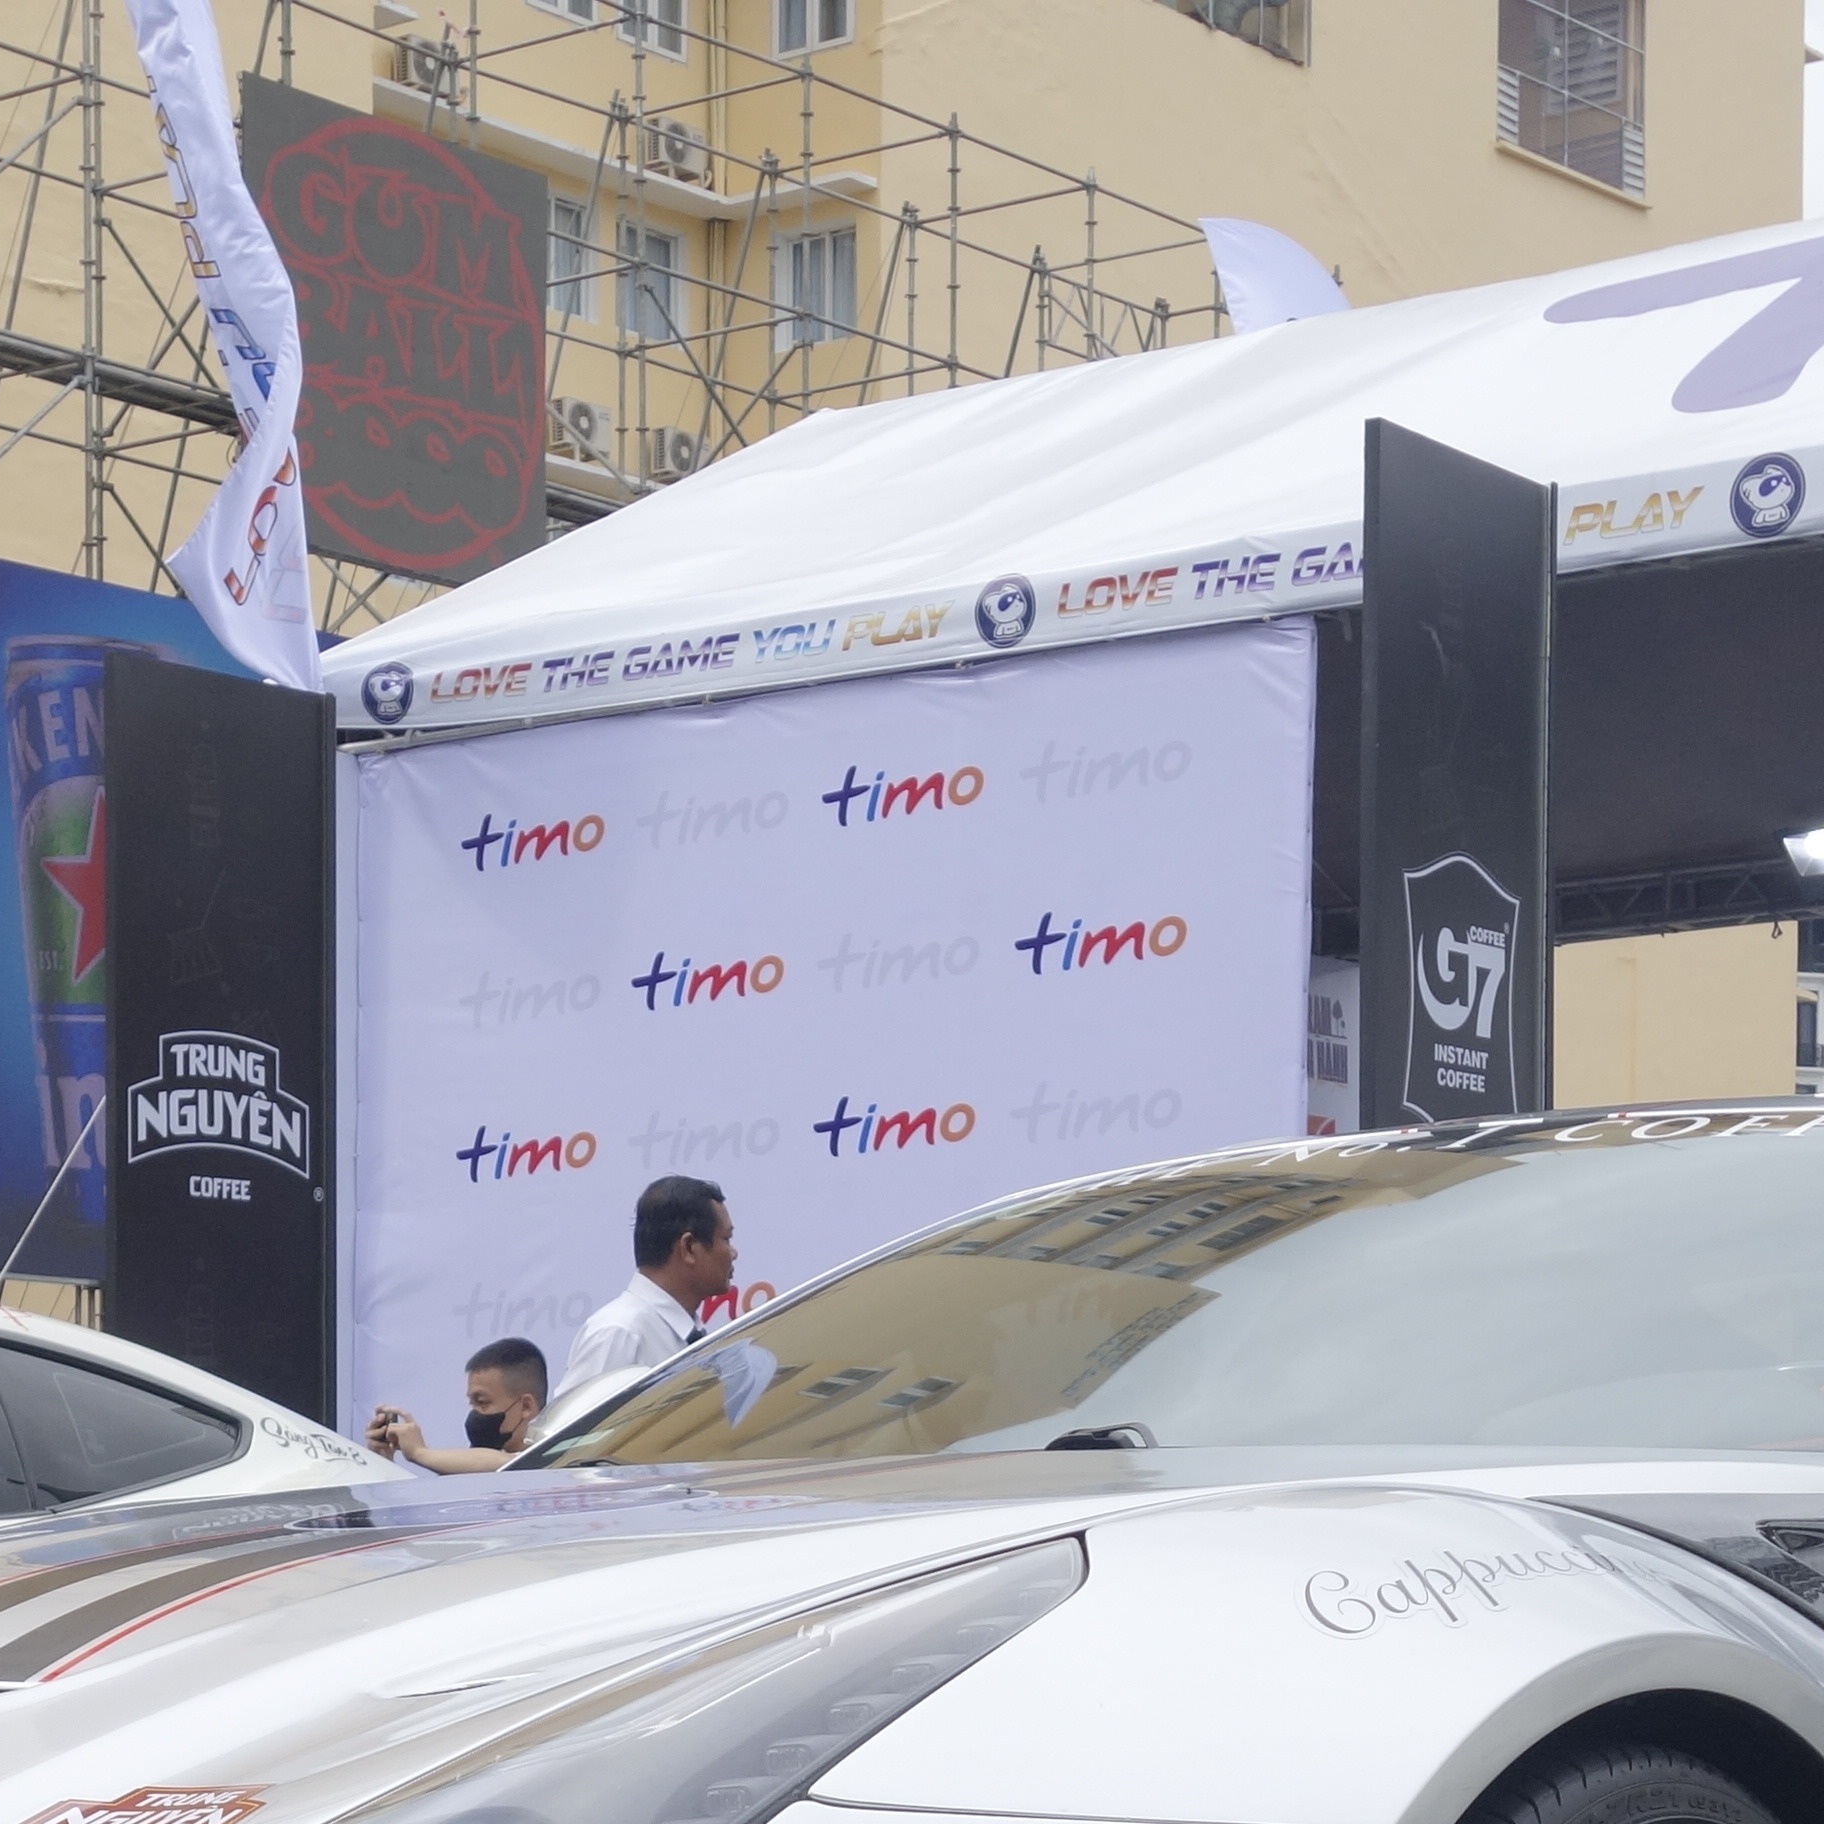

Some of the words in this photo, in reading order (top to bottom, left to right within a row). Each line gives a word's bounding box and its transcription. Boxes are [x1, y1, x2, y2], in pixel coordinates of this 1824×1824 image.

[1563, 485, 1705, 546] PLAY
[1057, 566, 1179, 619] LOVE
[1191, 552, 1281, 600] THE
[1290, 541, 1364, 587] GA
[429, 662, 533, 703] LOVE
[542, 650, 615, 693] THE
[622, 632, 740, 682] GAME
[752, 618, 836, 663] YOU
[842, 600, 954, 651] PLAY
[461, 813, 605, 872] timo
[636, 790, 789, 849] timo
[821, 765, 985, 827] timo
[1019, 739, 1193, 804] timo
[631, 951, 785, 1011] timo
[817, 932, 980, 993] timo
[1014, 911, 1188, 975] timo
[1469, 925, 1506, 948] COFFEE
[1417, 926, 1505, 1039] G7
[170, 1043, 266, 1087] TRUNG
[1434, 1043, 1489, 1070] INSTANT
[1437, 1068, 1486, 1093] COFFEE
[137, 1089, 301, 1158] NGUYÊN
[455, 1125, 597, 1184] timo
[627, 1109, 781, 1170] timo
[813, 1095, 976, 1158] timo
[1009, 1079, 1183, 1143] timo
[189, 1175, 251, 1200] COFFEE
[134, 1791, 247, 1808] TRUNG
